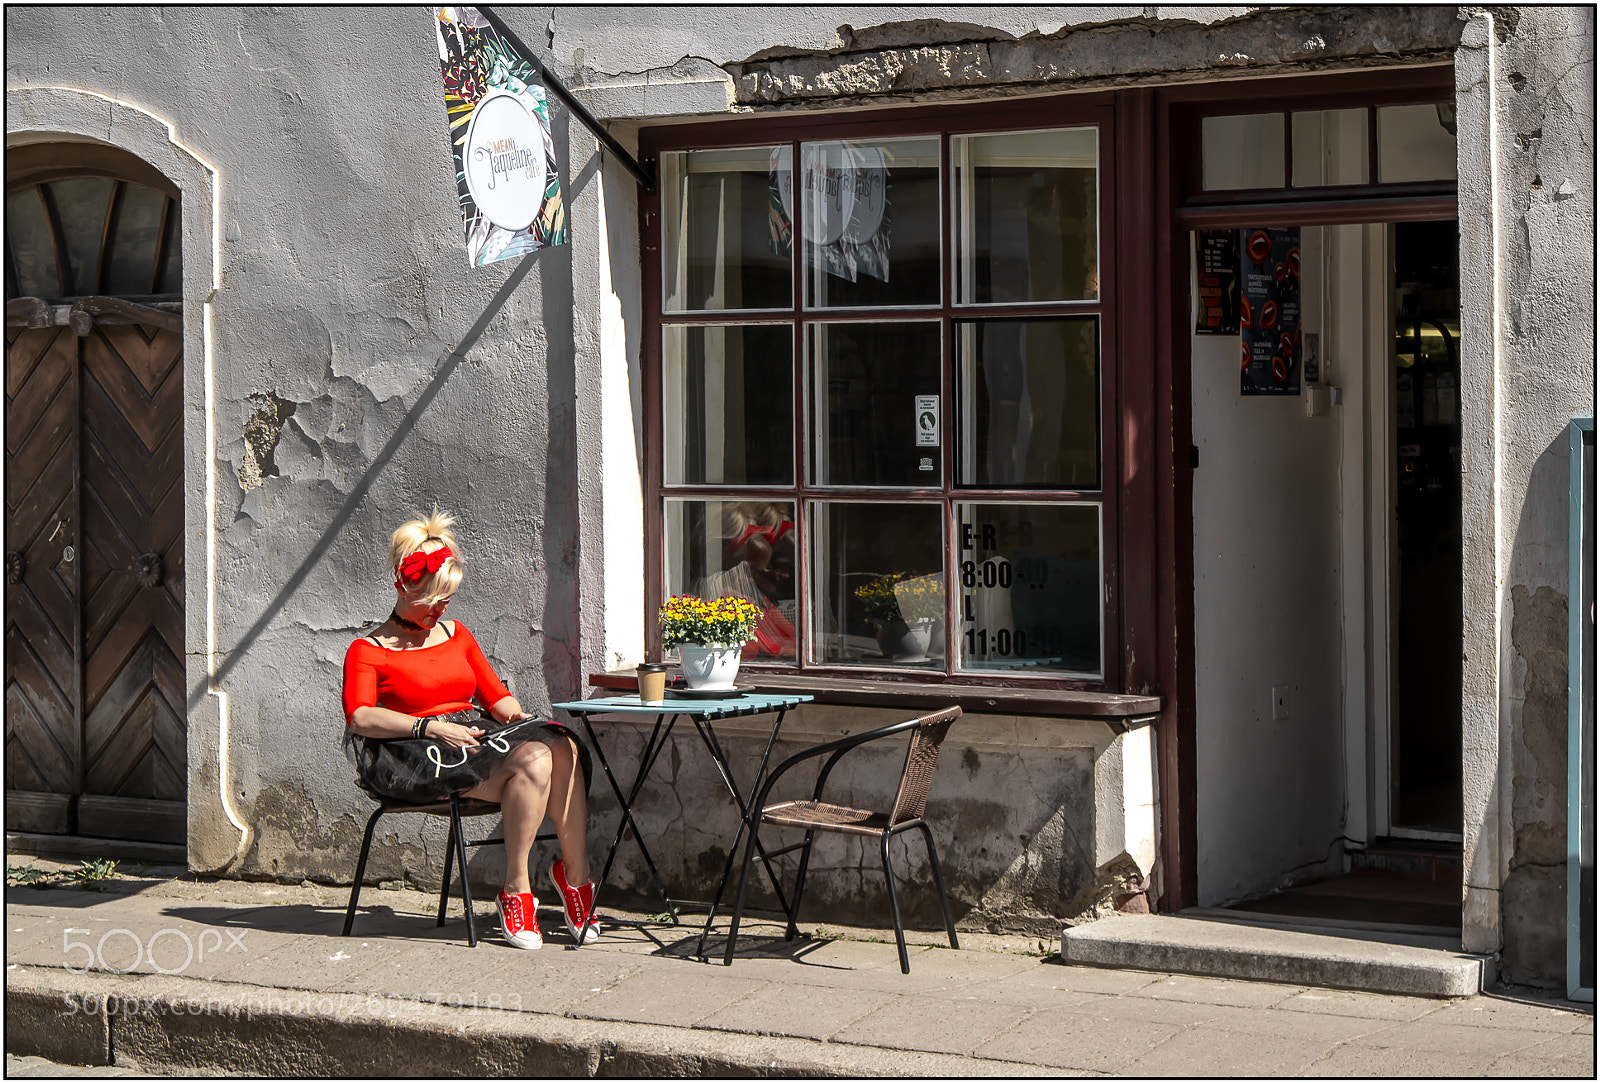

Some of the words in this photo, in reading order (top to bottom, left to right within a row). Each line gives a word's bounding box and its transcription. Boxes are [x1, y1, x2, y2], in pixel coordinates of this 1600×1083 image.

[493, 138, 513, 154] MEAN
[474, 140, 531, 190] Jaqueline
[962, 524, 996, 550] E-R
[964, 595, 975, 621] L
